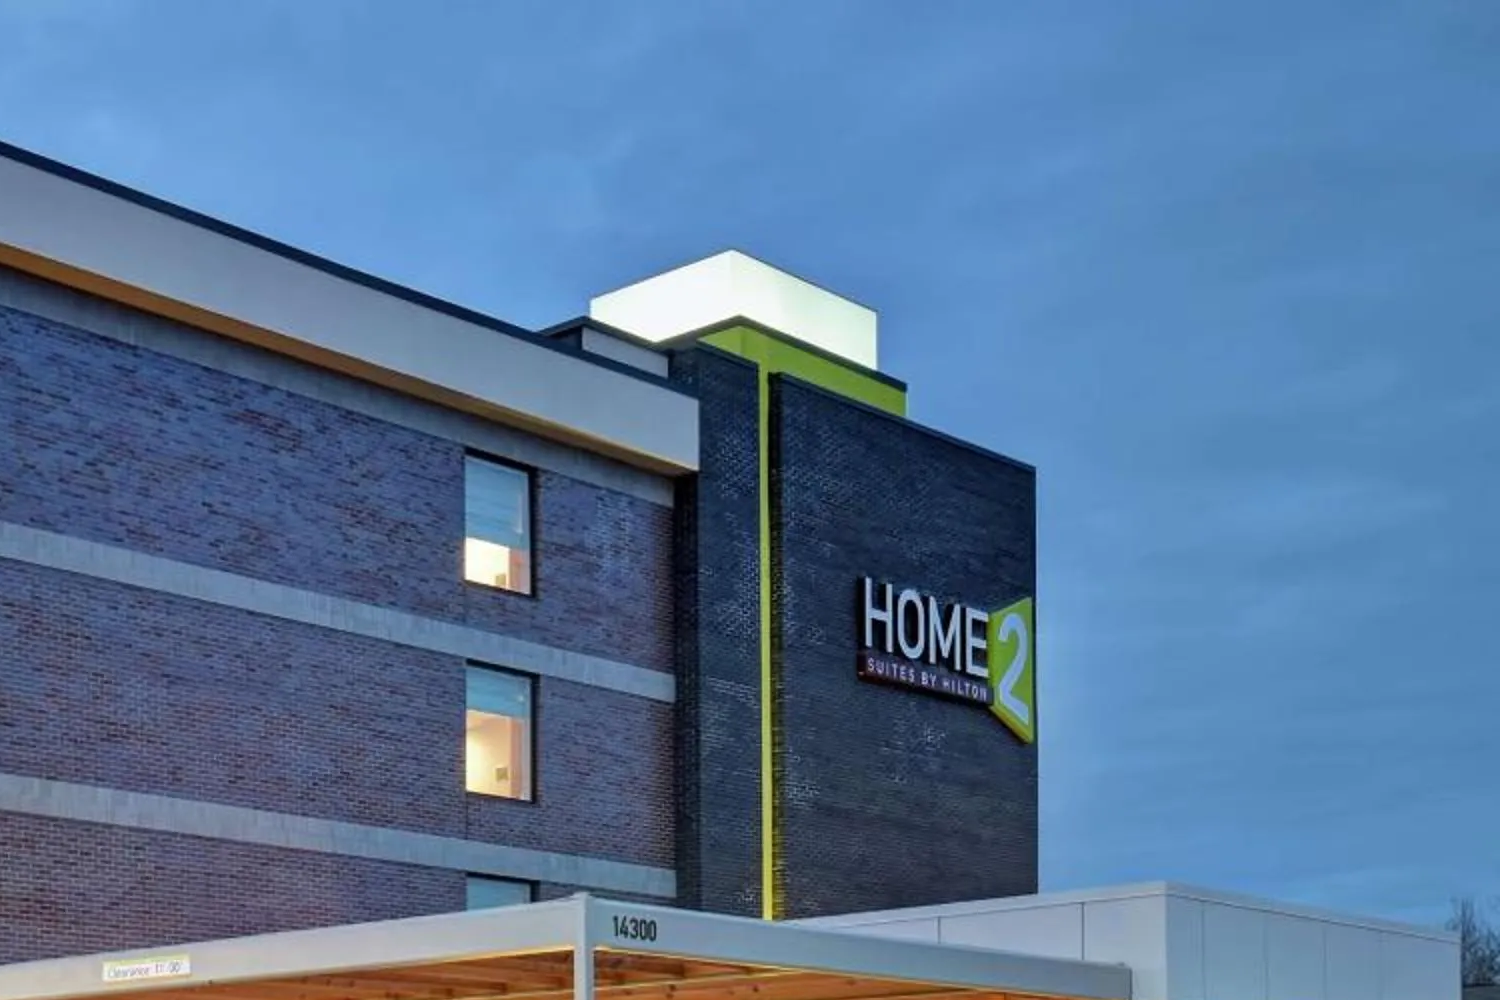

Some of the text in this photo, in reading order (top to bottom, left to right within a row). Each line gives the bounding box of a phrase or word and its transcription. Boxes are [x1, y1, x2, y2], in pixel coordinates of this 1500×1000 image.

[864, 576, 989, 678] HOME
[867, 657, 988, 702] SUITES BY HILTON
[612, 915, 657, 942] 14300
